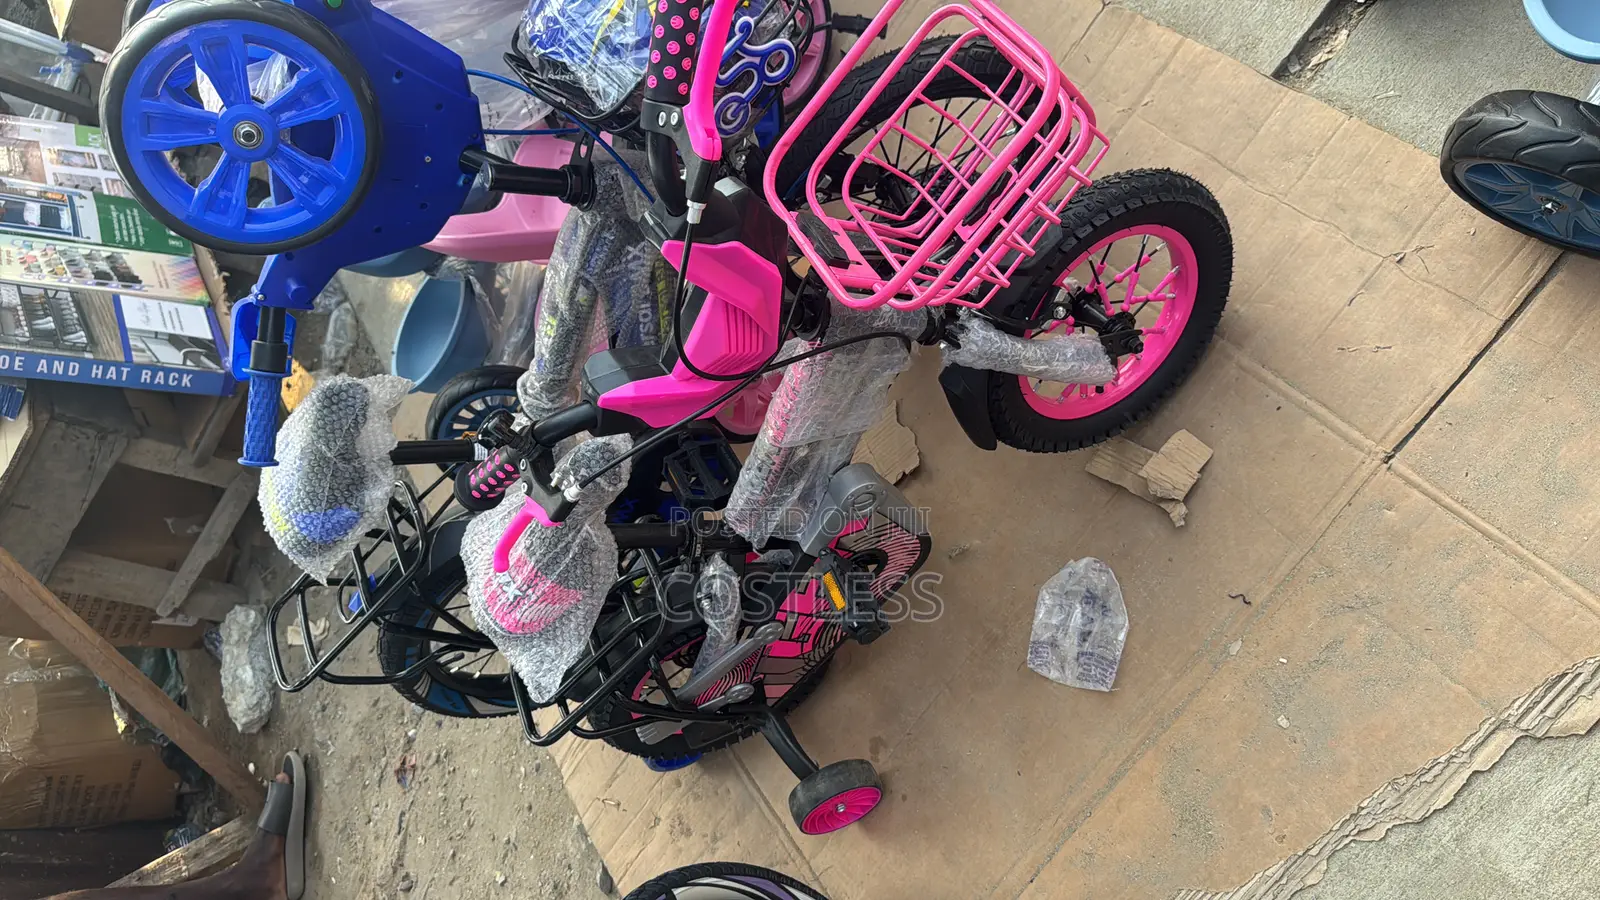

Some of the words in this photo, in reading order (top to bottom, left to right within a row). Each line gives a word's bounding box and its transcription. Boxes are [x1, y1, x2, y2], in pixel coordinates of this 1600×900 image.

[36, 358, 80, 377] AND
[91, 364, 131, 382] HAT
[140, 369, 193, 388] RACK
